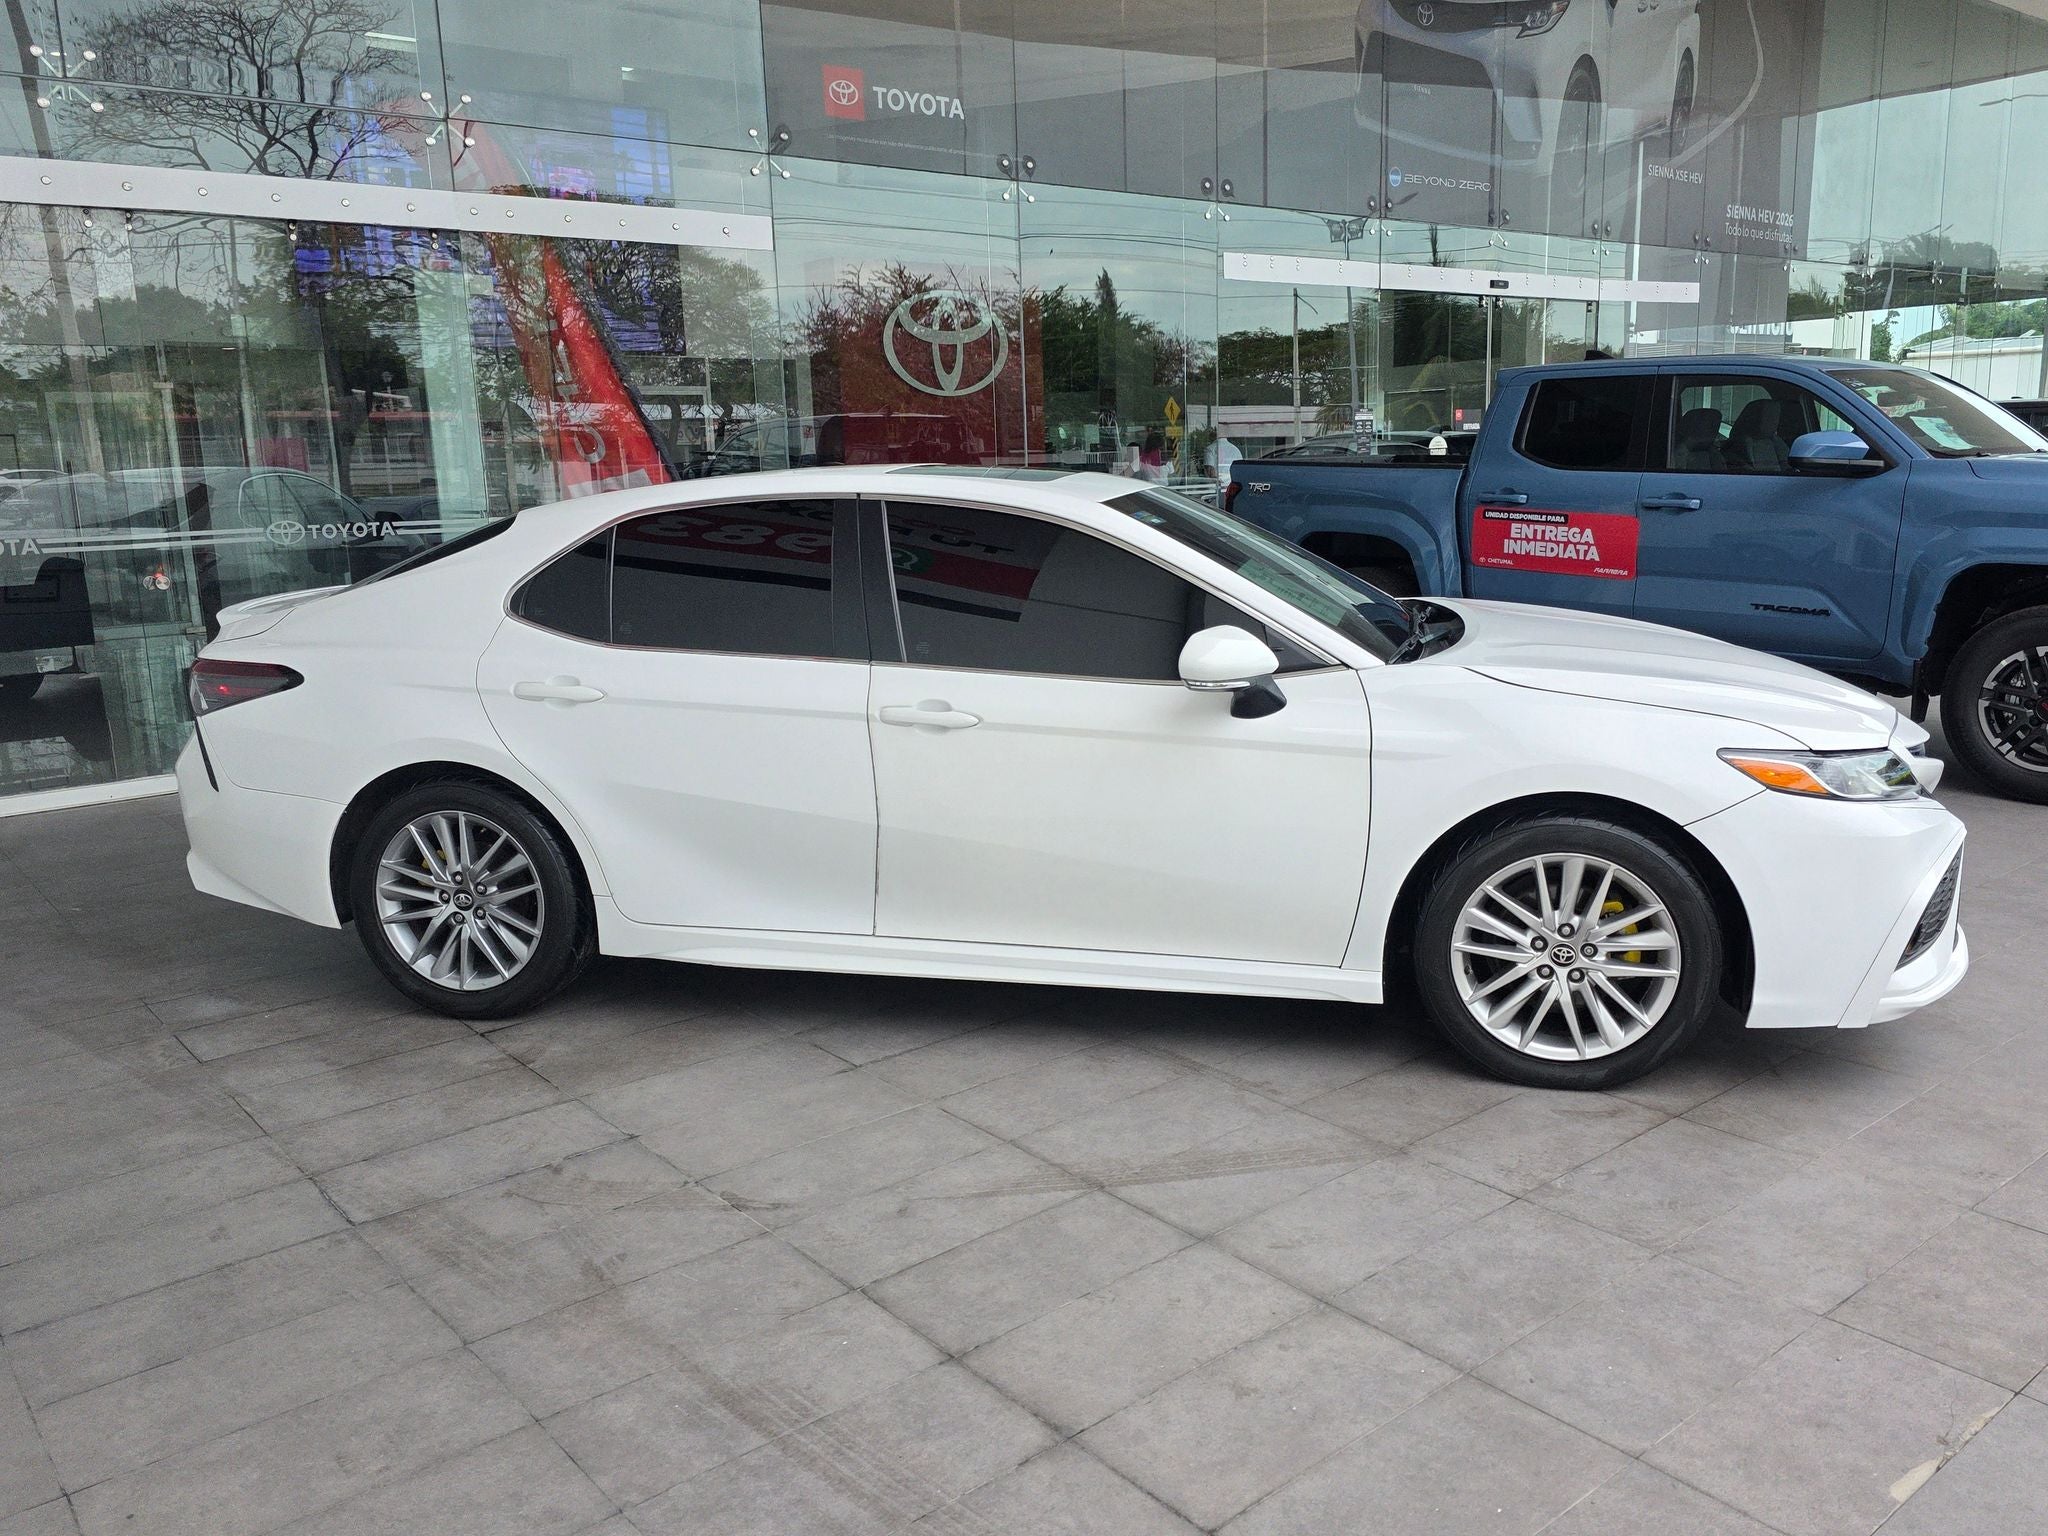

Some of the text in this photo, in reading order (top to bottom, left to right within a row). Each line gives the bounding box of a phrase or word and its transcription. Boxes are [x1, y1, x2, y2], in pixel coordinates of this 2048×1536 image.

[872, 86, 965, 120] TOYOTA
[1404, 173, 1491, 192] BEYOND ZERO
[1648, 164, 1703, 184] SIENNA XSE HEV
[1726, 204, 1794, 227] SIENNA HEV 2026
[1725, 222, 1793, 244] Todo lo que disfrutas
[1248, 482, 1271, 492] TRD
[1485, 511, 1566, 523] UNIDAD DISPONIBLE PARA
[308, 521, 396, 539] TOYOTA
[1510, 523, 1595, 545] ENTREGA
[1503, 538, 1601, 562] INMEDIATA
[1487, 557, 1514, 566] CHETUMAL
[1750, 602, 1831, 616] TACOMA
